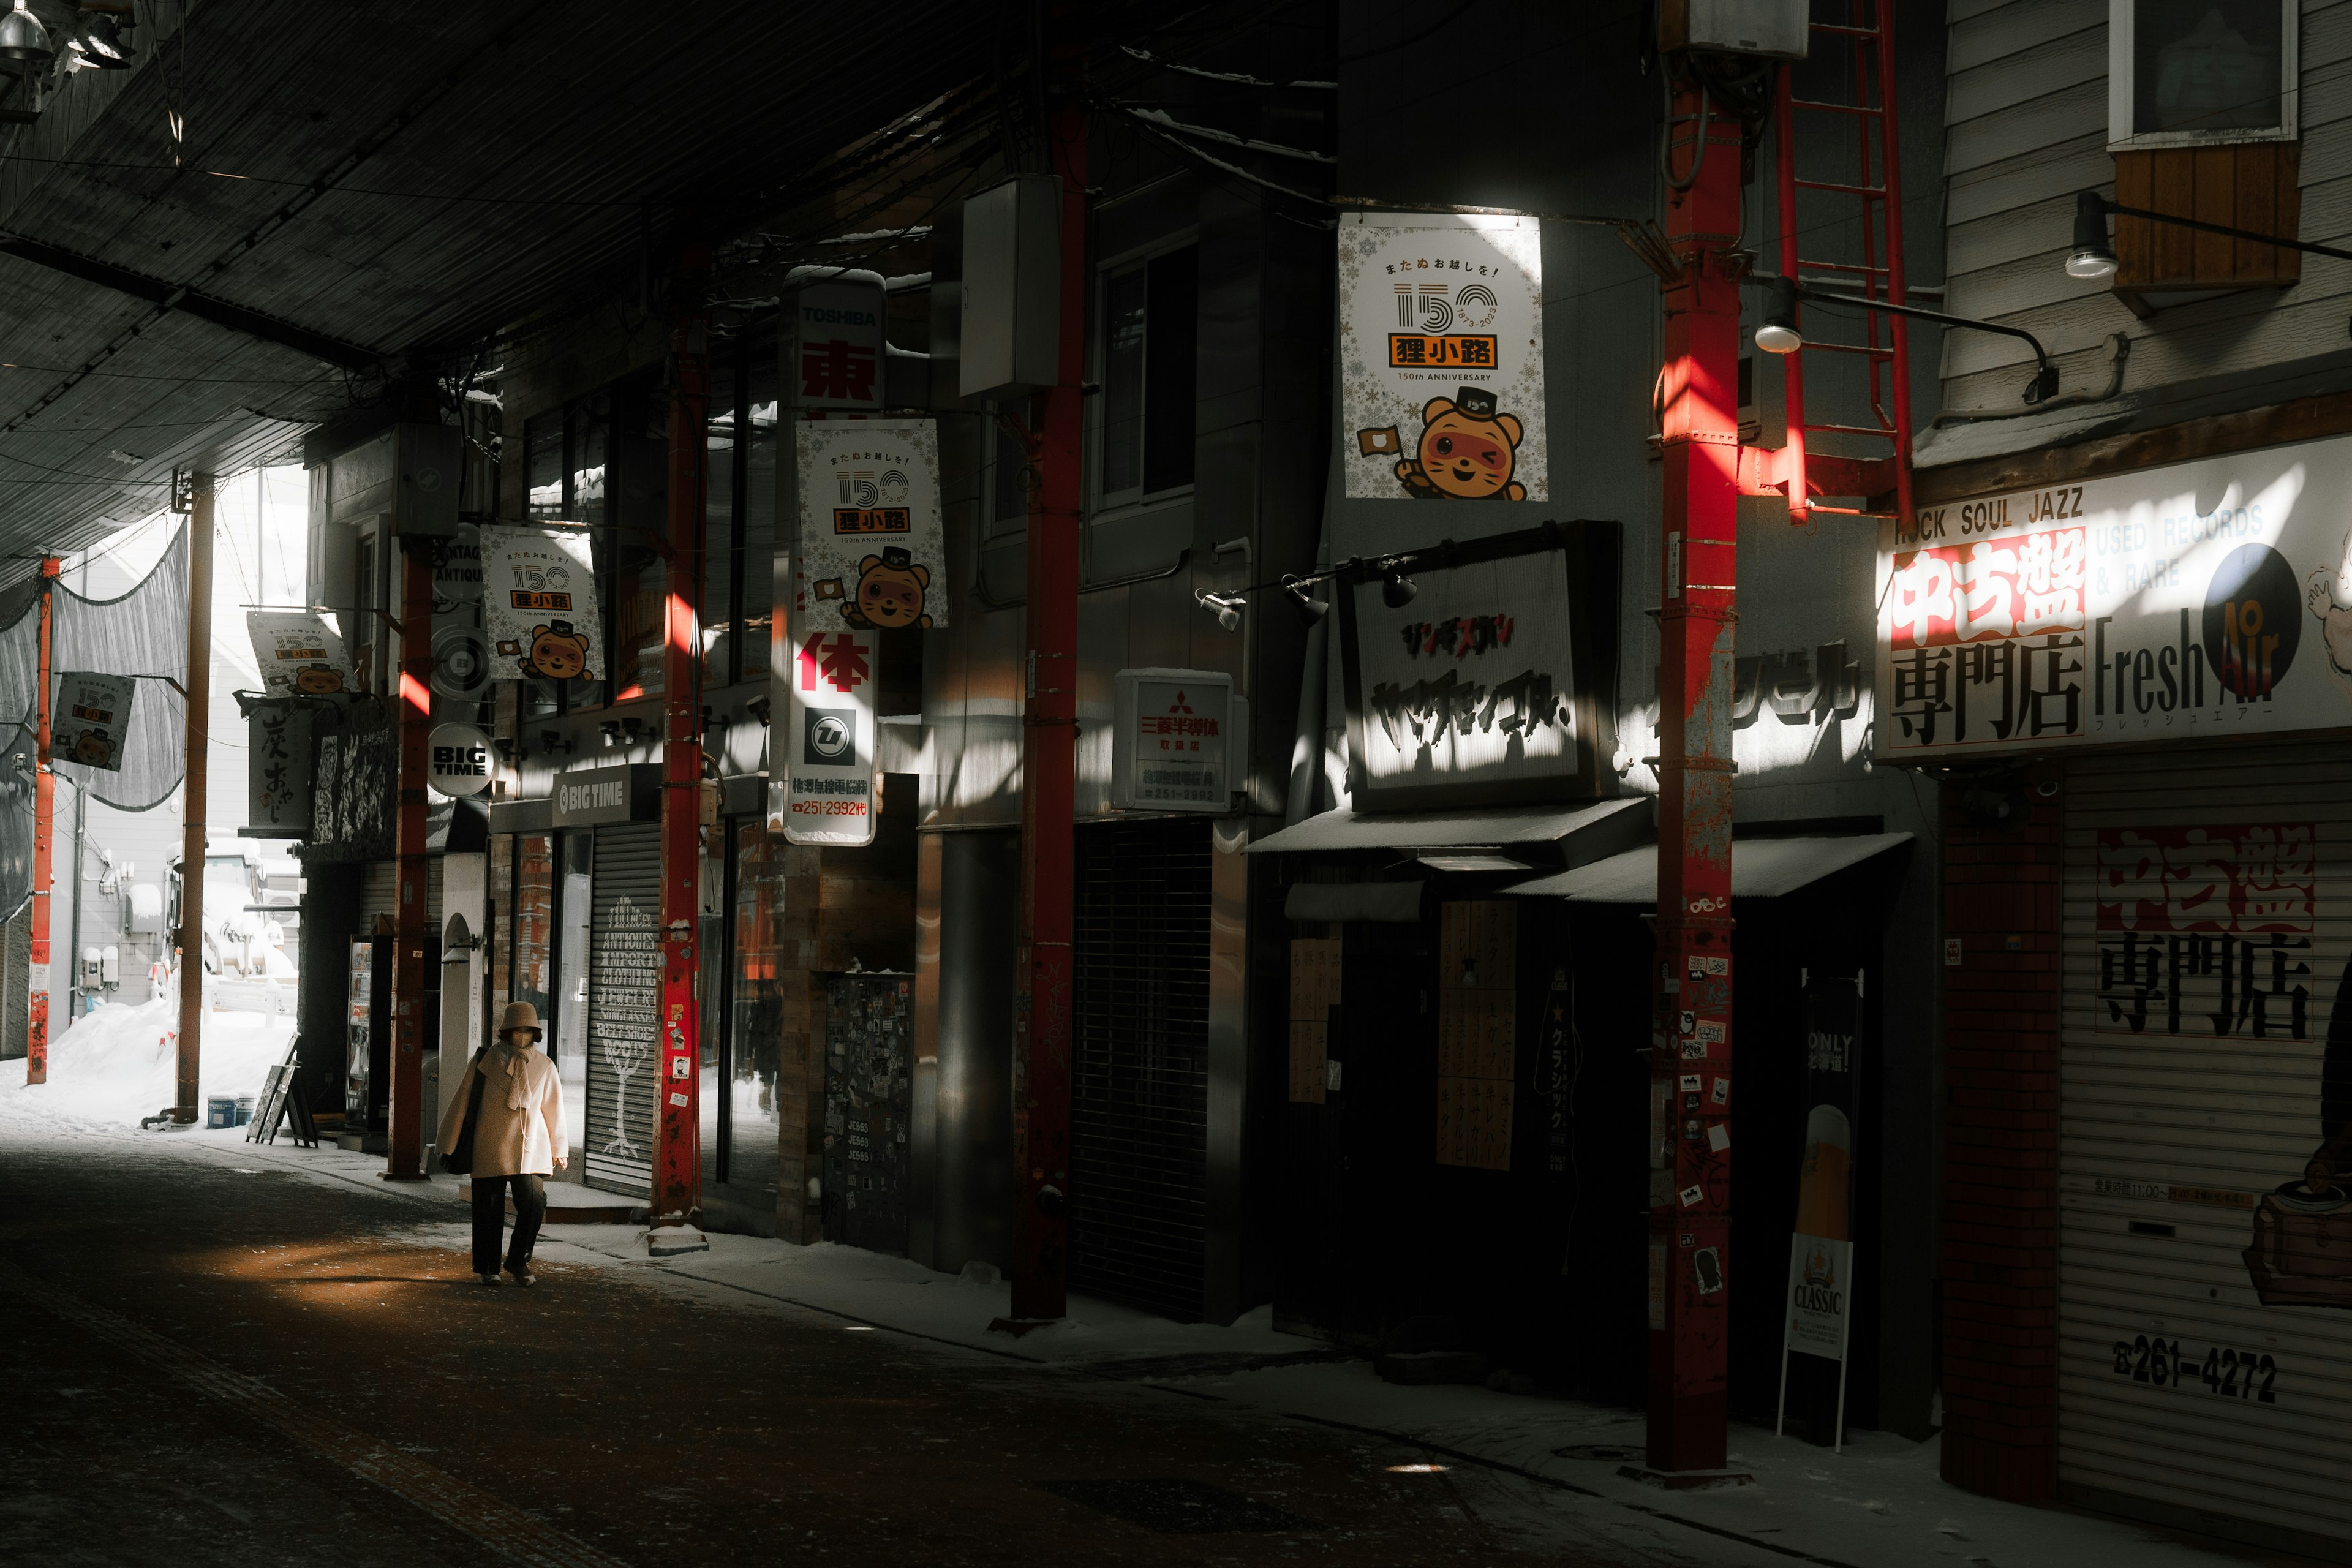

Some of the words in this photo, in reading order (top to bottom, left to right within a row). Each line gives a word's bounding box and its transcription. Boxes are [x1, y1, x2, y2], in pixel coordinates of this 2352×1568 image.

[1385, 258, 1499, 279] またぬお越しを!
[802, 307, 876, 327] TOSHIBA
[1394, 284, 1498, 333] 150
[1457, 307, 1497, 328] 1873-2023
[1396, 339, 1490, 364] 狸小路
[1398, 372, 1424, 381] 150th
[1427, 373, 1491, 382] ANNIVERSARY
[830, 452, 910, 467] またぬお越しを!
[837, 470, 910, 508] 150
[880, 487, 910, 503] 1873-2023
[840, 510, 905, 531] 狸小路
[1961, 508, 2013, 535] SOUL
[2028, 486, 2084, 523] JAZZ
[2096, 519, 2147, 556] USED
[2163, 505, 2264, 547] RECORDS
[511, 564, 570, 591] 150
[1889, 526, 2085, 645] 中古盤
[2126, 558, 2182, 591] RARE
[515, 592, 568, 608] 狸小路
[1401, 614, 1515, 659] ジンギスカン
[2095, 608, 2204, 715] Fresh
[2220, 599, 2280, 706] Air
[1891, 635, 2085, 745] 専門店
[1141, 716, 1218, 737] 三菱半導体
[2095, 706, 2273, 731] フレッシュエアー
[434, 746, 486, 764] BIG
[1160, 739, 1200, 752] 取扱店
[434, 764, 486, 777] TIME
[569, 784, 590, 810] BIG
[591, 781, 623, 808] TIME
[1155, 788, 1214, 801] 251-2992
[2098, 827, 2314, 932] 中古盤
[602, 932, 655, 951] ANTIQUES
[1489, 908, 1498, 980] ラムタン
[599, 951, 657, 967] IMPORT
[601, 968, 657, 986] CLOTHING
[2098, 932, 2312, 1040] 専門店
[598, 987, 657, 1005] JEWELRY
[600, 1008, 657, 1023] SUNGLASSES
[595, 1022, 624, 1038] BELT
[625, 1025, 657, 1041] SHOES
[1487, 1002, 1499, 1068] 上ガツ
[1809, 1032, 1852, 1052] ONLY
[602, 1039, 649, 1065] BOOTS
[1314, 1033, 1324, 1093] キムチ
[1551, 1028, 1564, 1128] クラシック
[1441, 1089, 1451, 1153] 牛タン
[1455, 1084, 1466, 1161] 牛カルビ
[1470, 1083, 1481, 1164] 牛サガリ
[1485, 1085, 1496, 1165] 牛レバー
[1501, 1093, 1511, 1160] 牛ミノ
[1550, 1155, 1566, 1164] ONLY
[1794, 1284, 1842, 1315] CLASSIC
[2134, 1335, 2277, 1404] 261-4272
